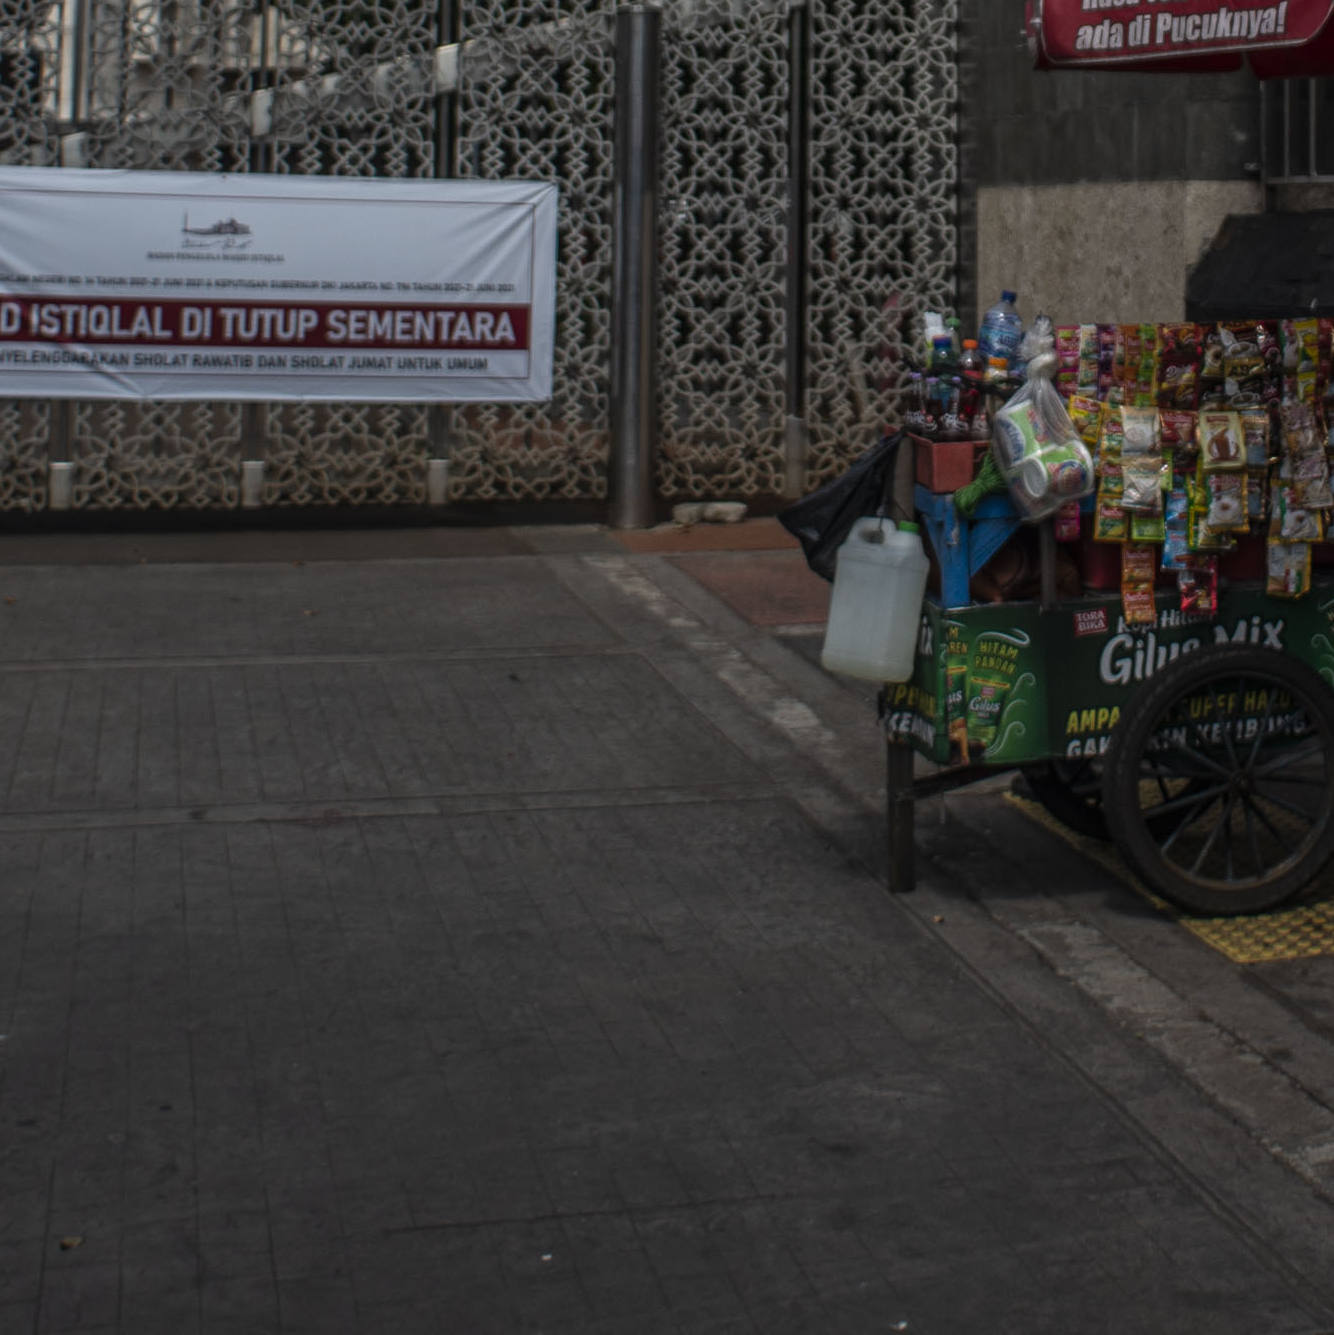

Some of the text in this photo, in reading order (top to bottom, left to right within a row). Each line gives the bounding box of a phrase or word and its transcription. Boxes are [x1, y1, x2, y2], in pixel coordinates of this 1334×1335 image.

[1075, 0, 1288, 52] ada di Pucuknya!
[30, 303, 173, 339] ISTIQLAL
[180, 306, 212, 340] DI
[218, 308, 319, 341] TUTUP
[326, 310, 517, 344] SEMENTARA
[133, 353, 189, 366] SHOLAT
[192, 354, 253, 367] RAWATIB
[258, 355, 286, 367] DAN
[291, 355, 344, 368] SHOLAT
[348, 357, 392, 369] JUMAT
[397, 357, 442, 370] UNTUK
[447, 358, 488, 370] UMUM
[1076, 610, 1105, 622] TORA
[1077, 621, 1105, 632] BIKA
[1213, 615, 1285, 650] Mix
[979, 641, 1019, 660] HITAM
[969, 696, 1001, 712] Gilus
[1066, 705, 1120, 735] AMPA
